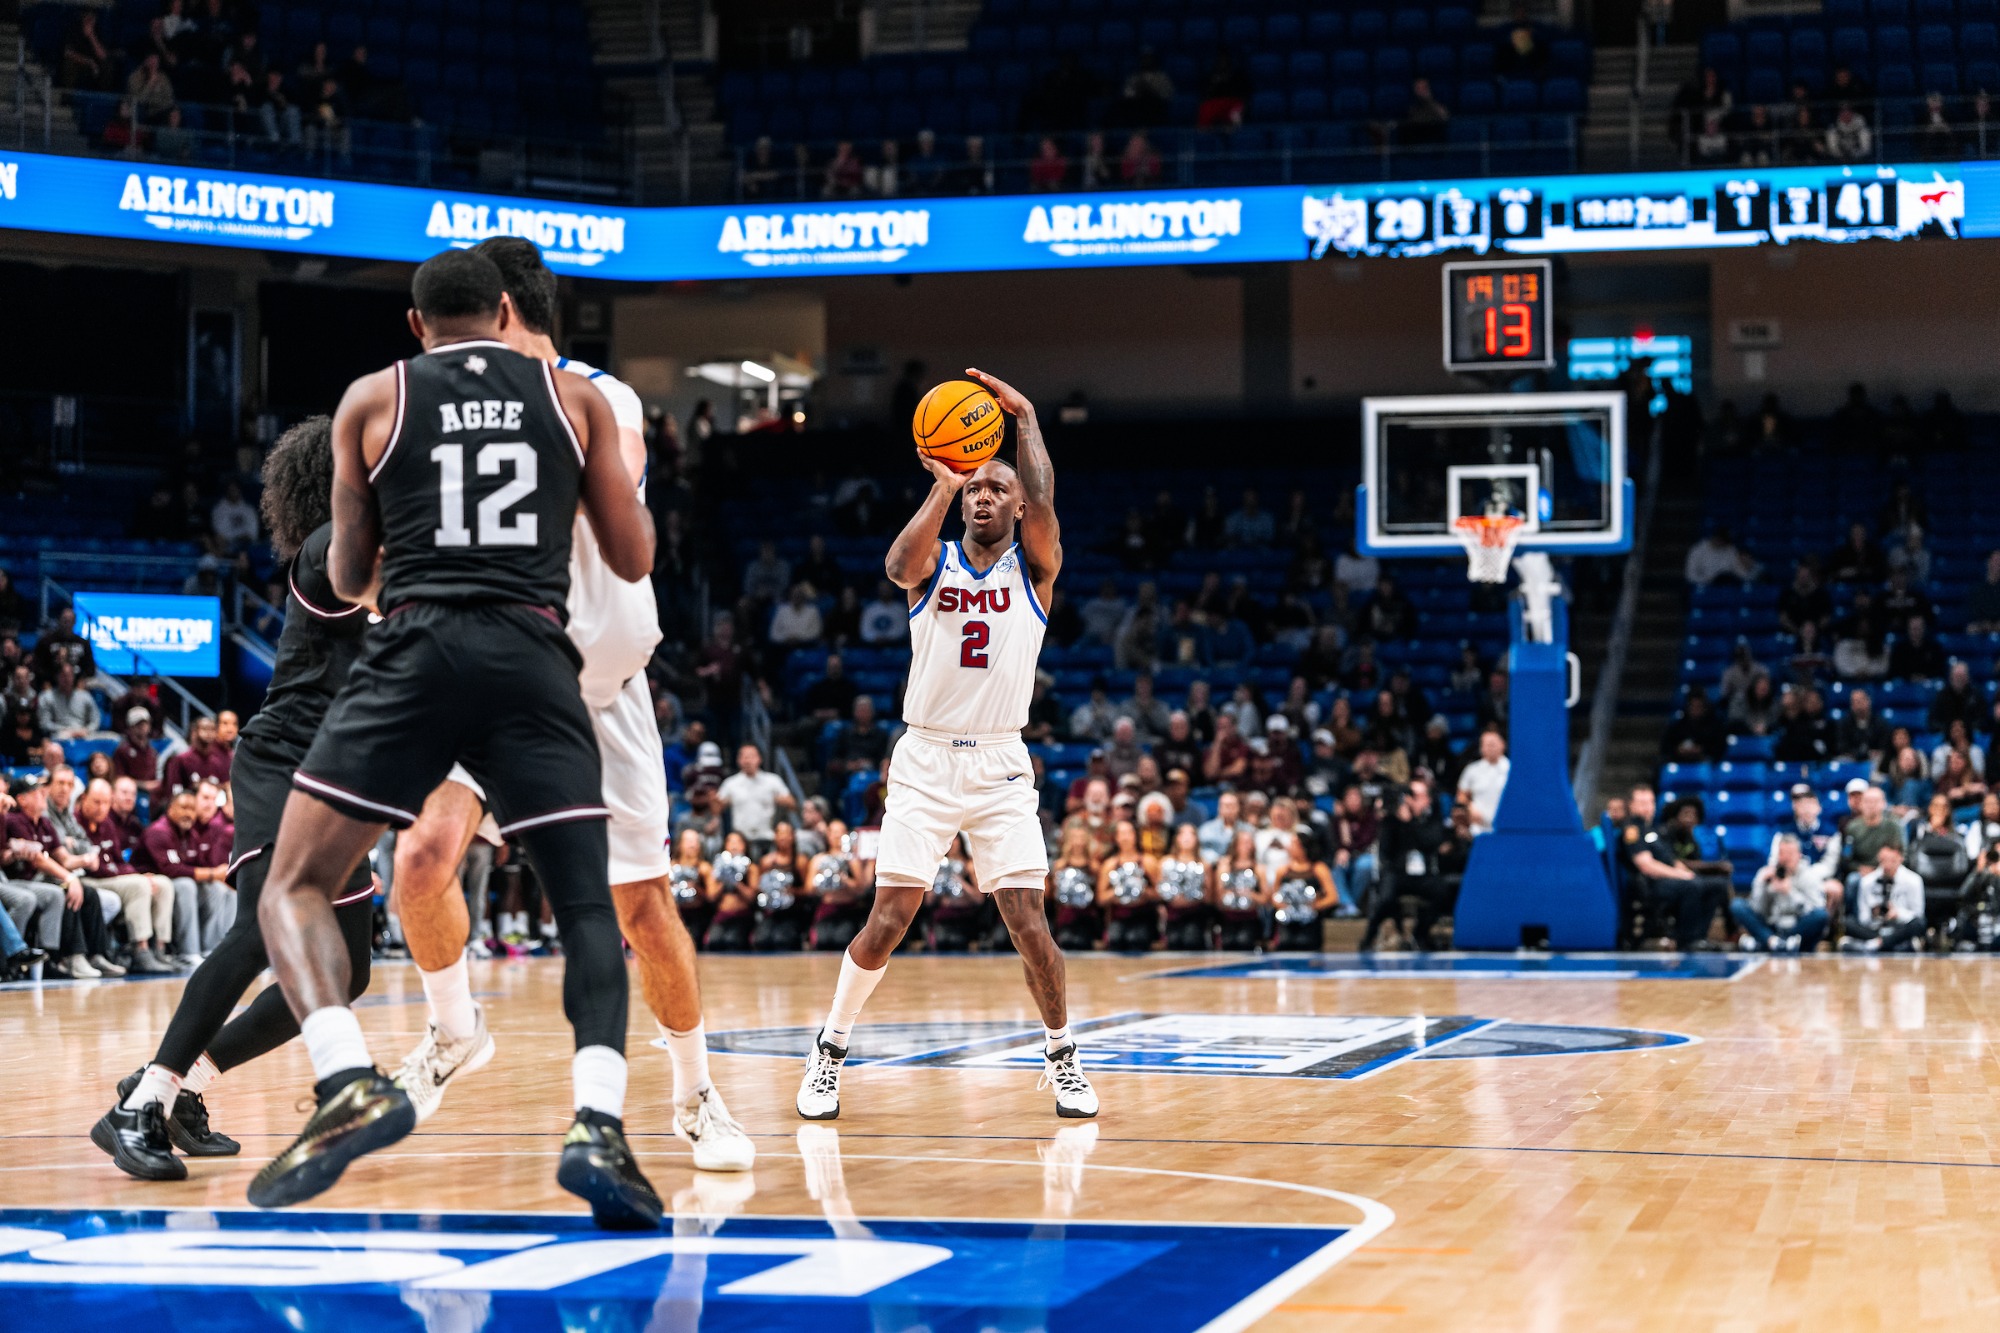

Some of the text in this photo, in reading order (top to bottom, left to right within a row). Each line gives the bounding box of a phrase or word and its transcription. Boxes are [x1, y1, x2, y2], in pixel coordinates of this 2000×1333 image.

[119, 173, 335, 227] ARLINGTON
[1022, 198, 1242, 243] ARLINGTON
[1375, 198, 1426, 241] 29
[1835, 182, 1884, 225] 41
[425, 200, 626, 254] ARLINGTON
[717, 210, 930, 253] ARLINGTON
[1484, 303, 1532, 357] 13
[439, 400, 524, 433] AGEE
[960, 400, 995, 428] NCAA
[430, 442, 538, 546] 12
[937, 587, 1011, 613] SMU
[960, 620, 990, 669] 2
[952, 739, 977, 748] SMU
